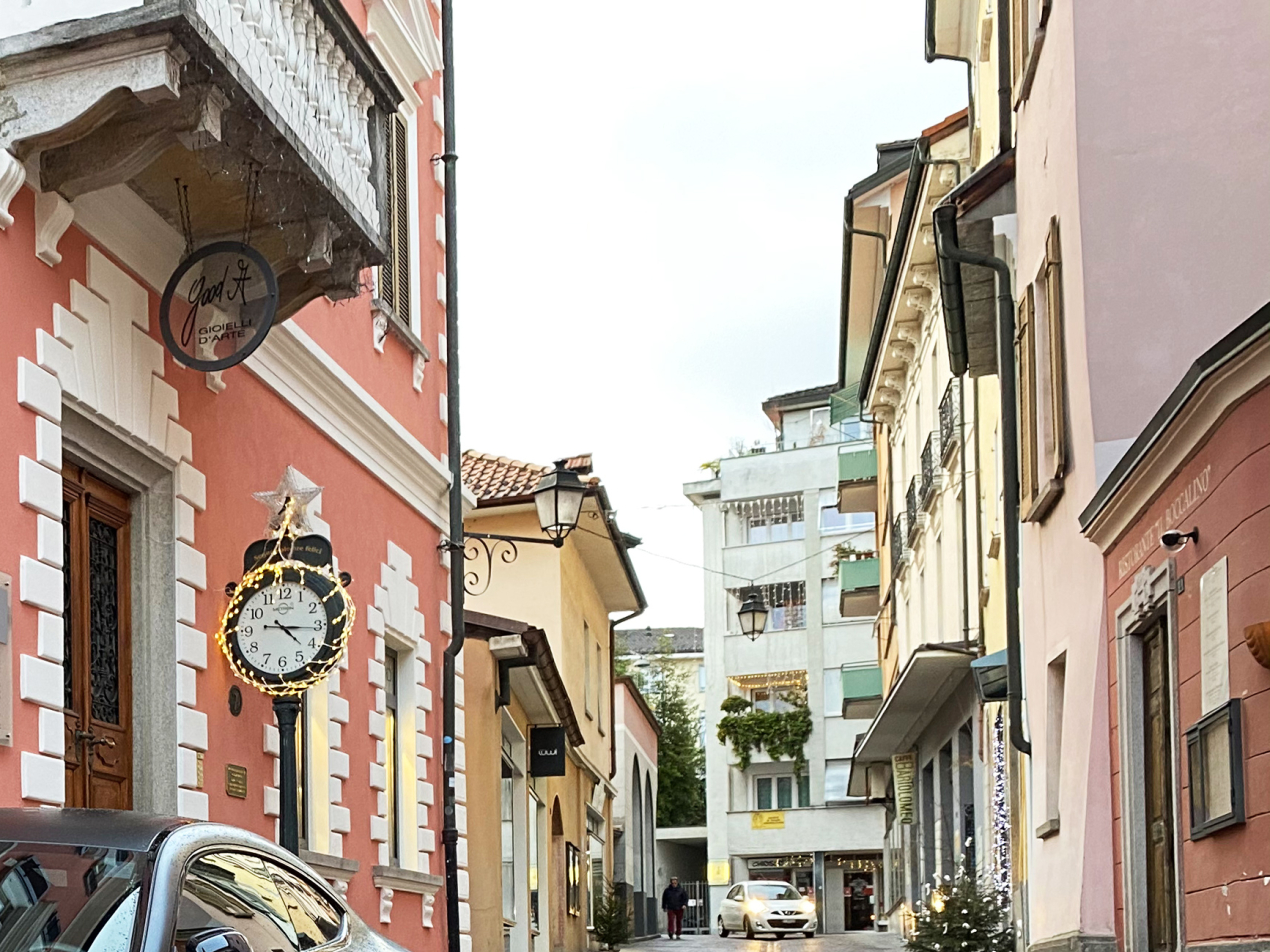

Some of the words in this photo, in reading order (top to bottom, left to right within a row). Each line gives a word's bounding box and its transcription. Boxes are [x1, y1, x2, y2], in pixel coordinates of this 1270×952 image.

[199, 319, 251, 335] GIOIELLI
[199, 329, 245, 344] D'ARTE
[263, 594, 273, 605] 11
[279, 588, 292, 600] 12
[298, 591, 303, 602] 1
[251, 608, 264, 619] 10
[309, 602, 317, 614] 2
[314, 620, 322, 631] 3
[244, 626, 253, 637] 9
[250, 642, 258, 653] 8
[308, 638, 316, 648] 4
[263, 653, 271, 664] 7
[278, 656, 287, 667] 6
[295, 651, 303, 662] 5
